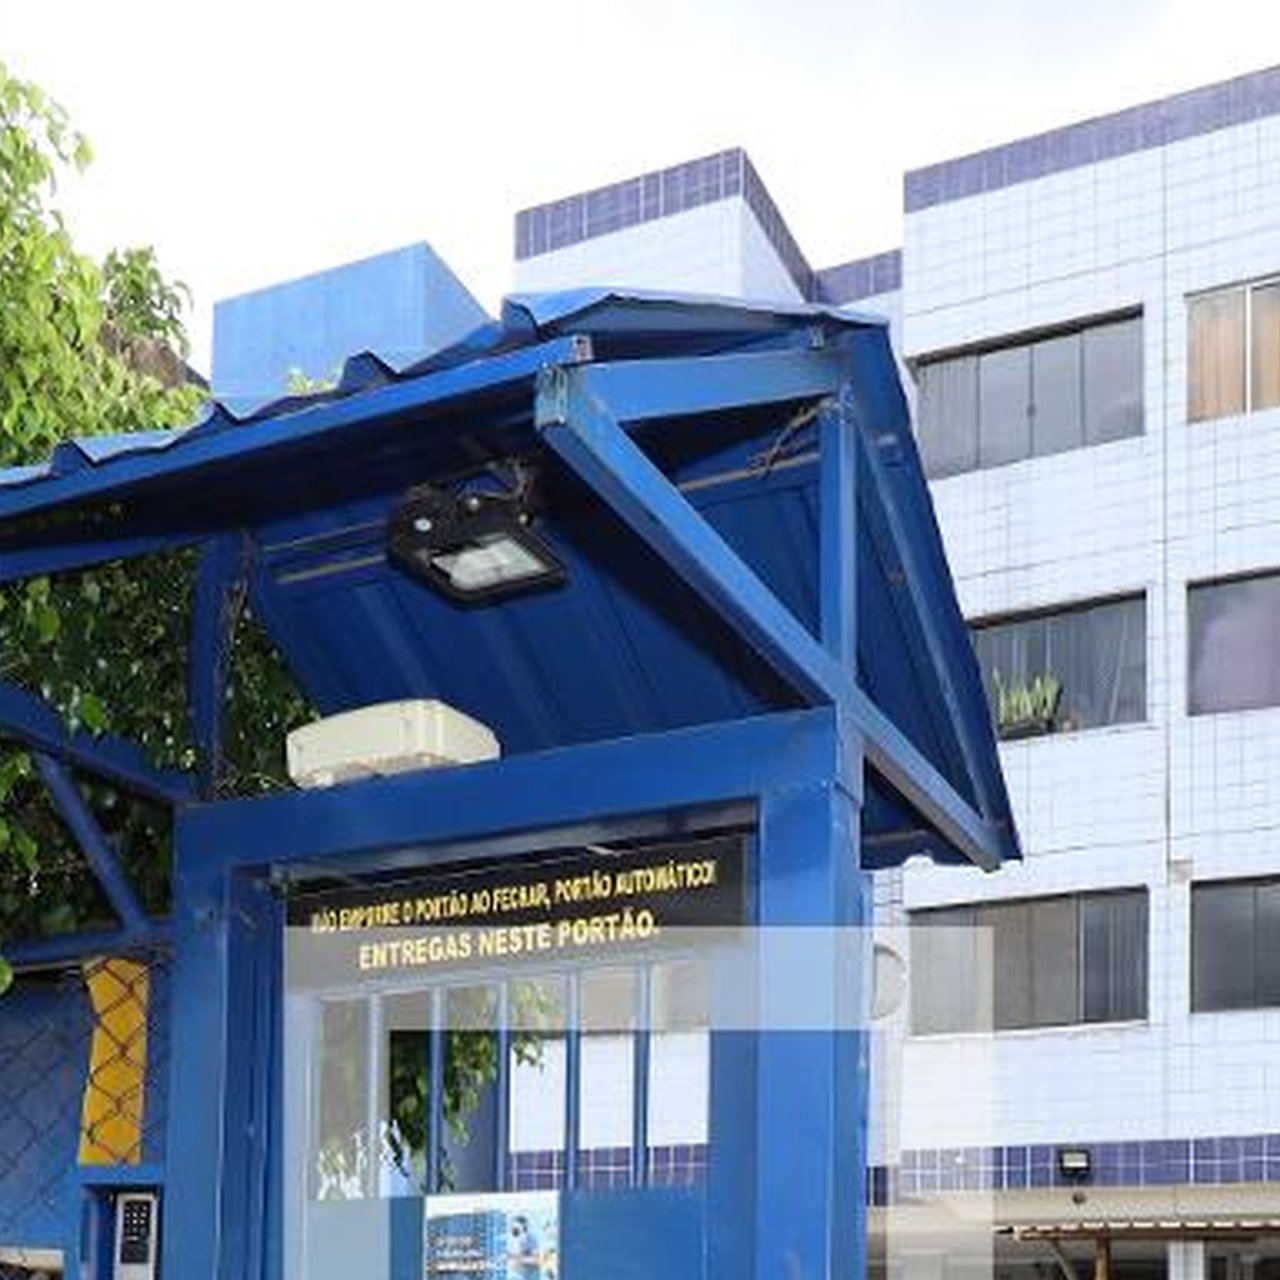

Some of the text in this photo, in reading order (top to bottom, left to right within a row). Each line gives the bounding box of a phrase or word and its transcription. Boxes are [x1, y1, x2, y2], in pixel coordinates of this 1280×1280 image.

[403, 901, 414, 923] O
[359, 931, 471, 970] ENTREGAS
[479, 922, 551, 956] NESTE
